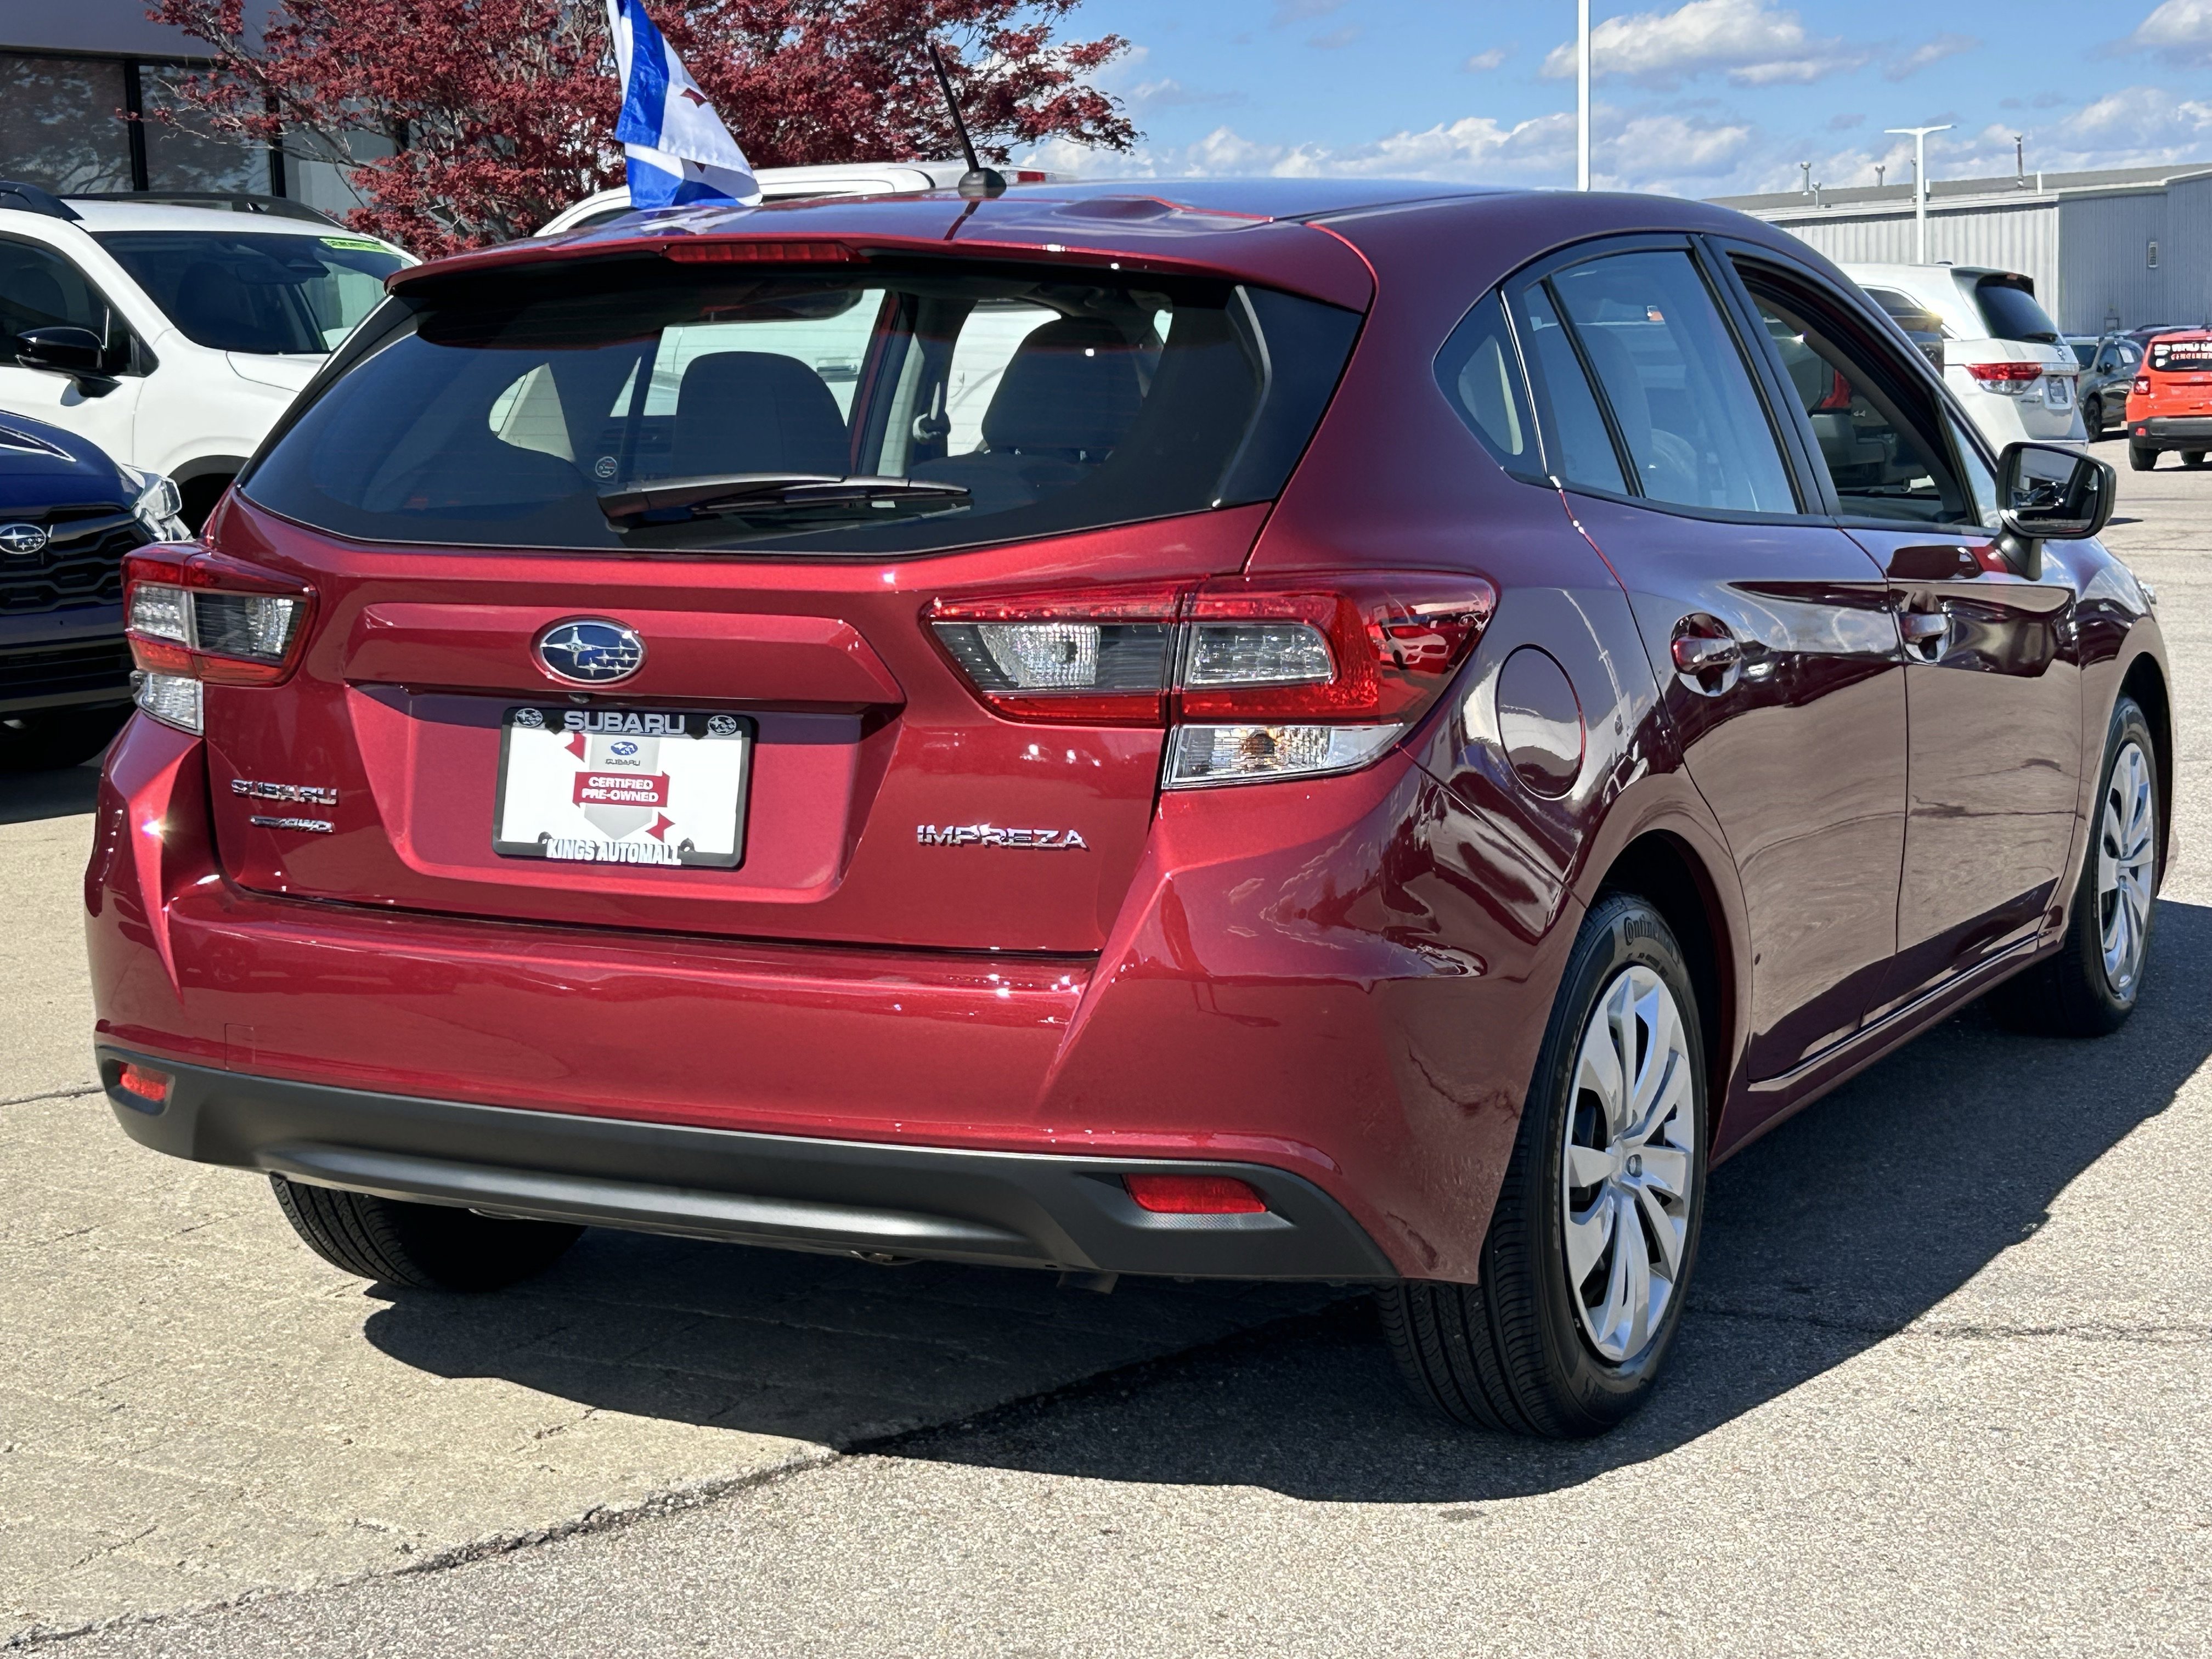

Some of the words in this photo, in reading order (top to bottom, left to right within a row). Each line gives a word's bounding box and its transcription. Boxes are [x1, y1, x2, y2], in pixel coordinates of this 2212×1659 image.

[564, 710, 685, 735] SUBARU
[231, 779, 337, 805] SUBARU
[582, 788, 659, 803] PRE-OWNED
[589, 777, 653, 790] CERTIFIED
[917, 823, 1087, 849] IMPREZA
[546, 839, 595, 861] KINGS
[596, 842, 682, 865] AUTOMALL
[1623, 913, 1680, 968] Contin
